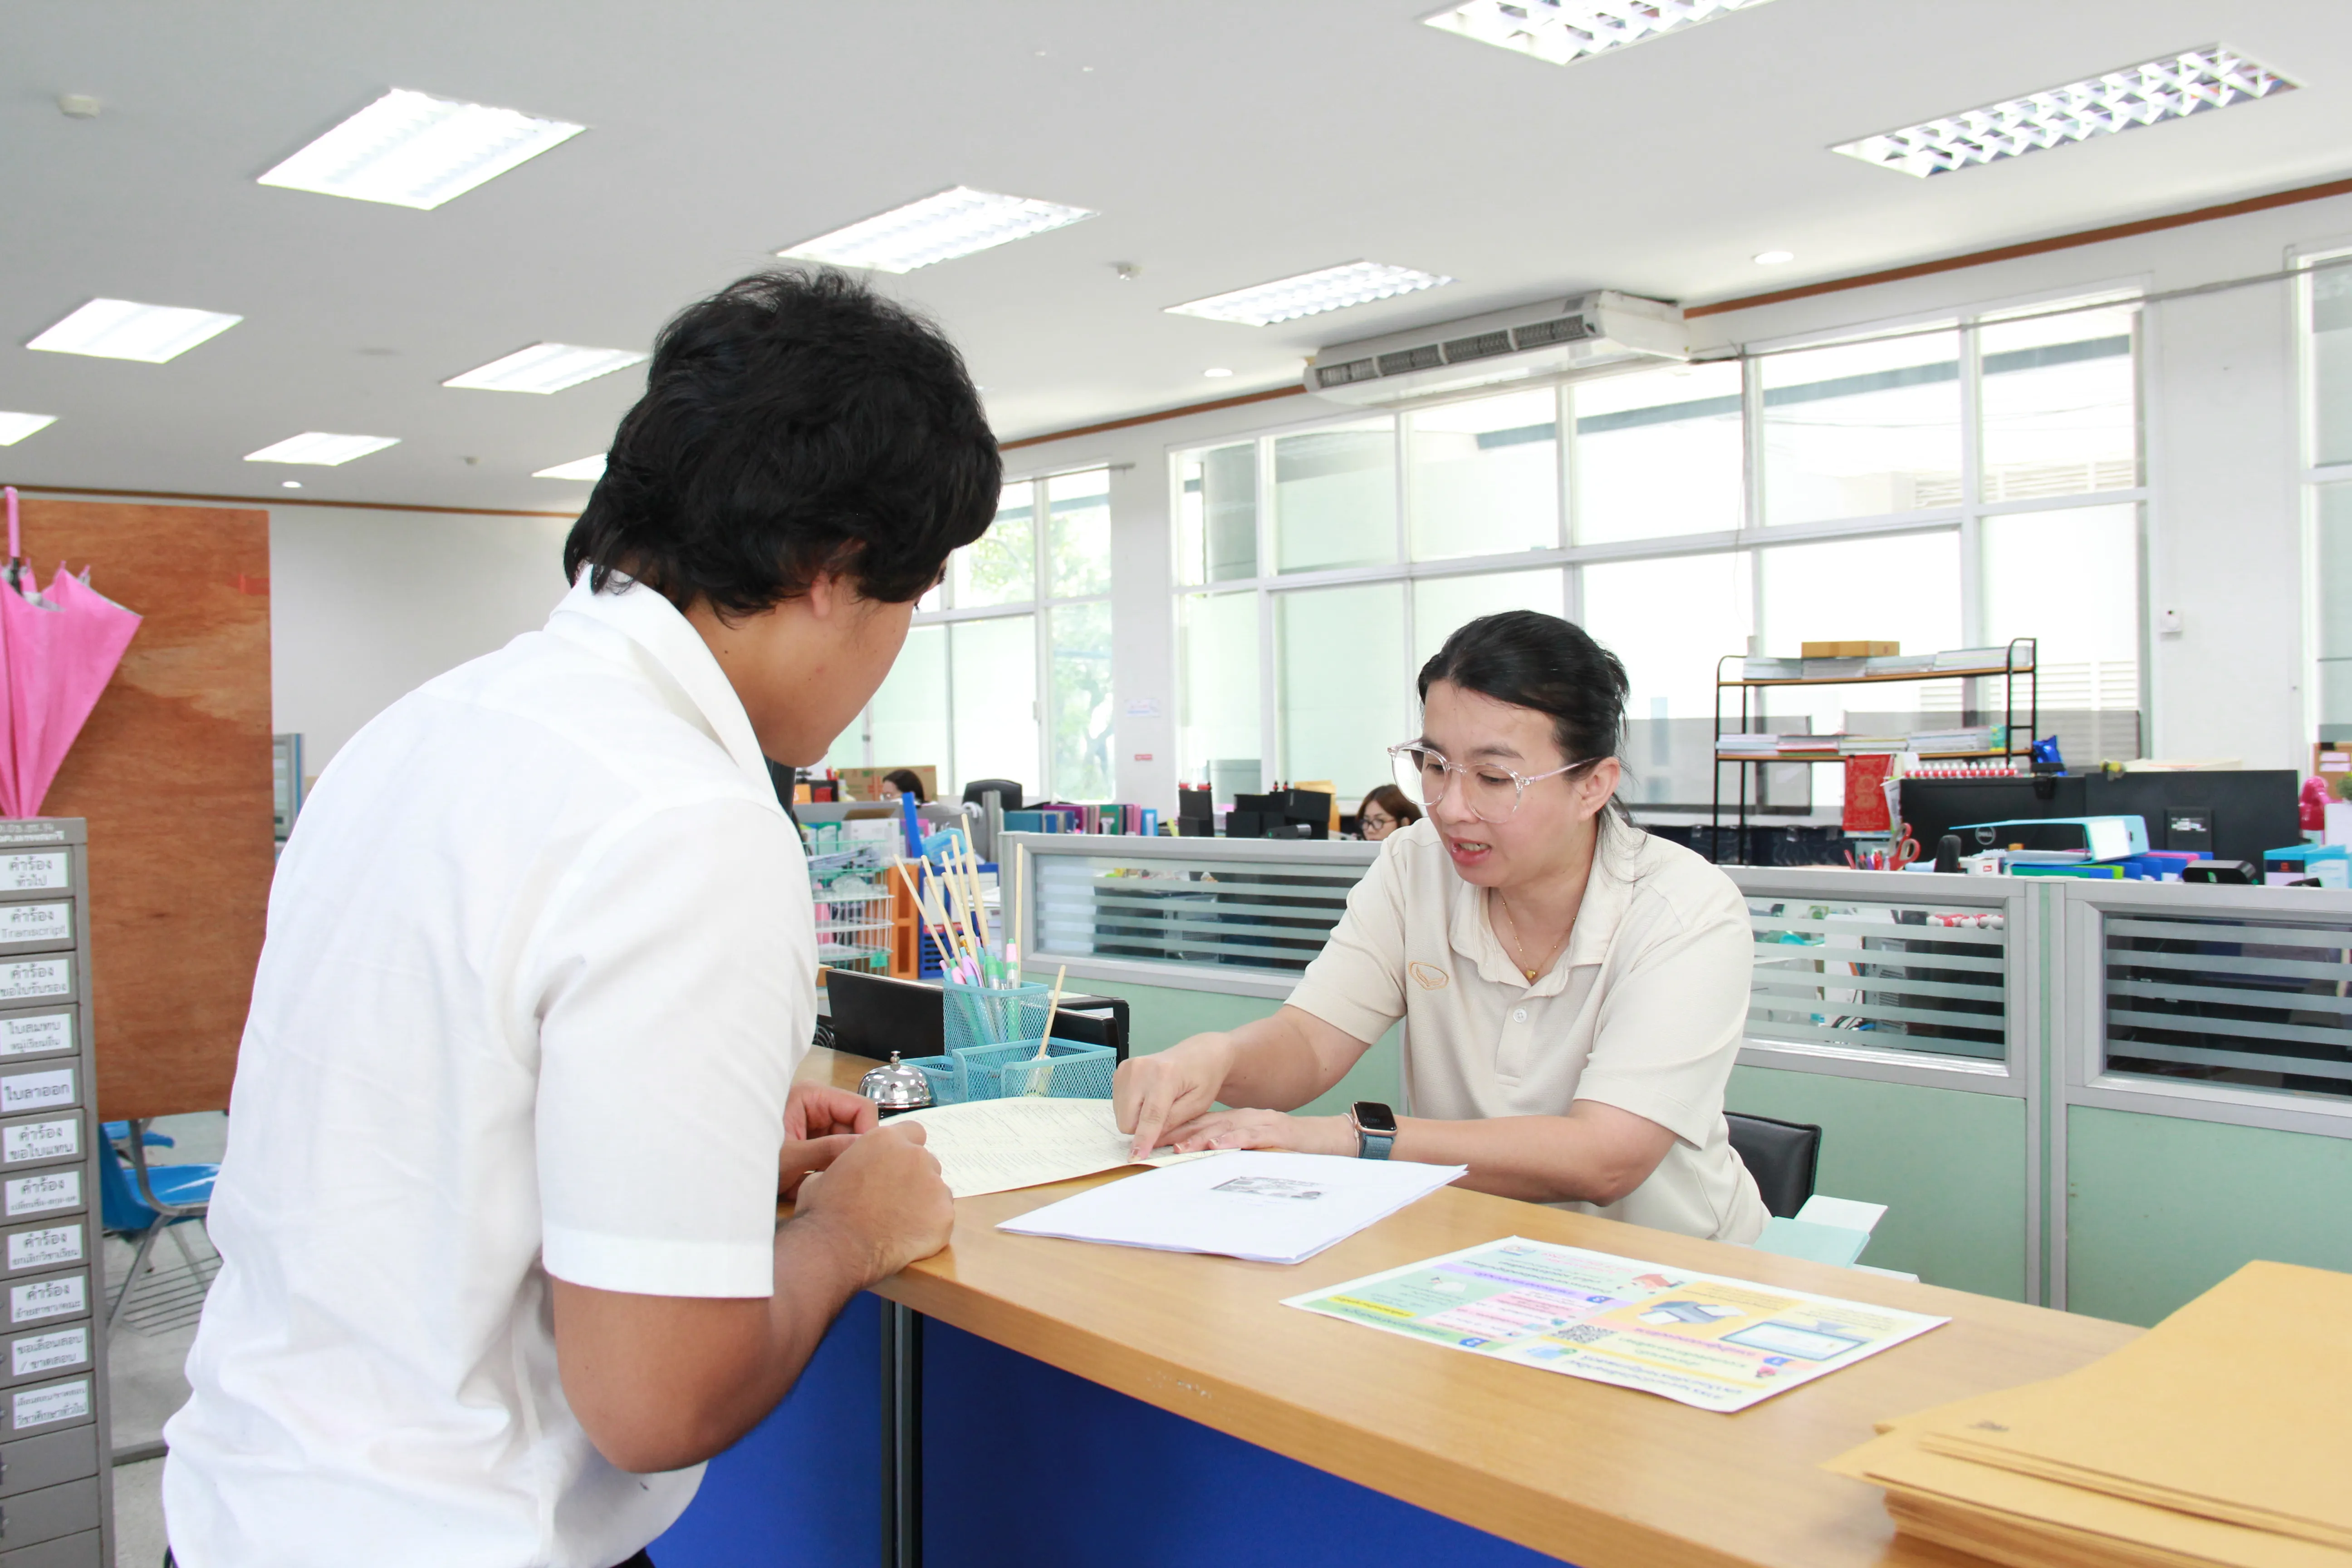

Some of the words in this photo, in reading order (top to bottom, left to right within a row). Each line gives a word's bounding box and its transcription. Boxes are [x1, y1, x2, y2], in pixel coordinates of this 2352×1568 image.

[1, 924, 66, 939] Transcript
[4, 1083, 70, 1101] ใบลาออก
